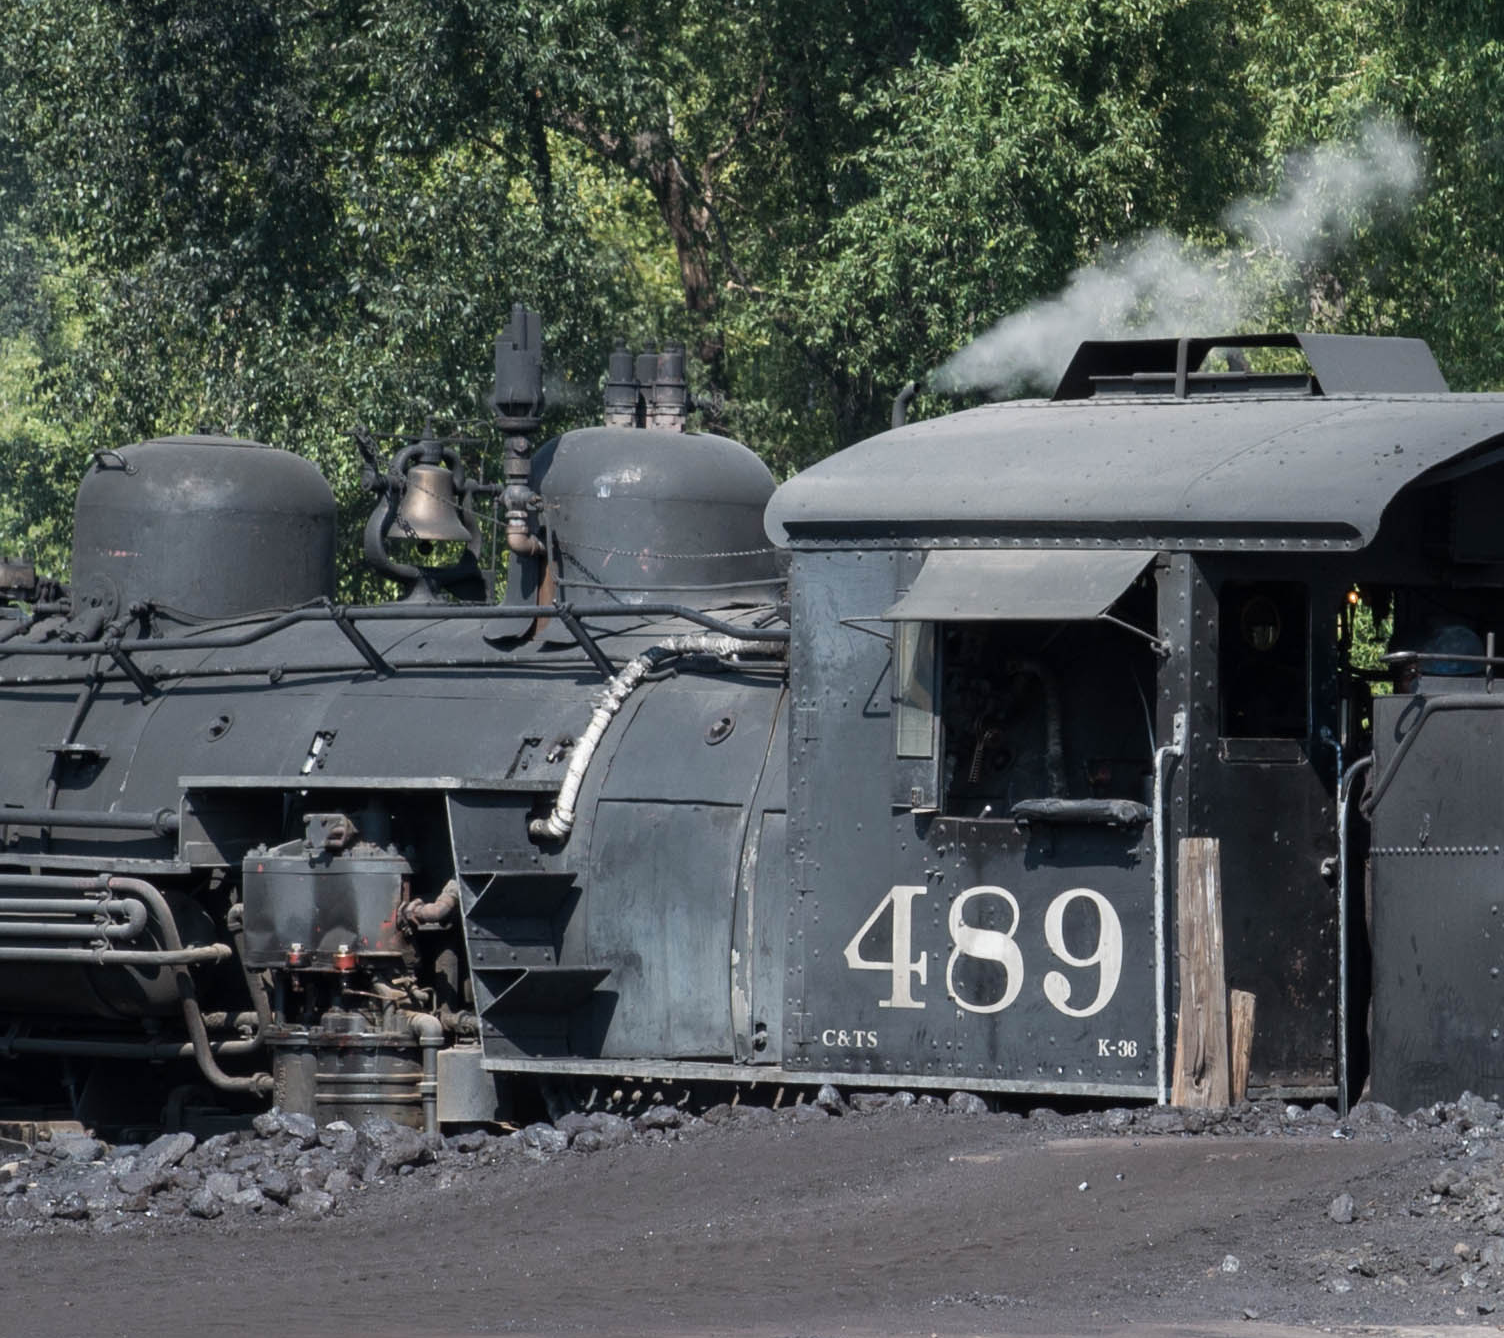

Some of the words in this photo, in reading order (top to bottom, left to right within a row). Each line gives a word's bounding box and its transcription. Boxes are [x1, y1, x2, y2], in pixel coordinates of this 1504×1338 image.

[843, 885, 1123, 1018] 489
[822, 1029, 878, 1047] C&TS
[1098, 1039, 1138, 1057] K-36
